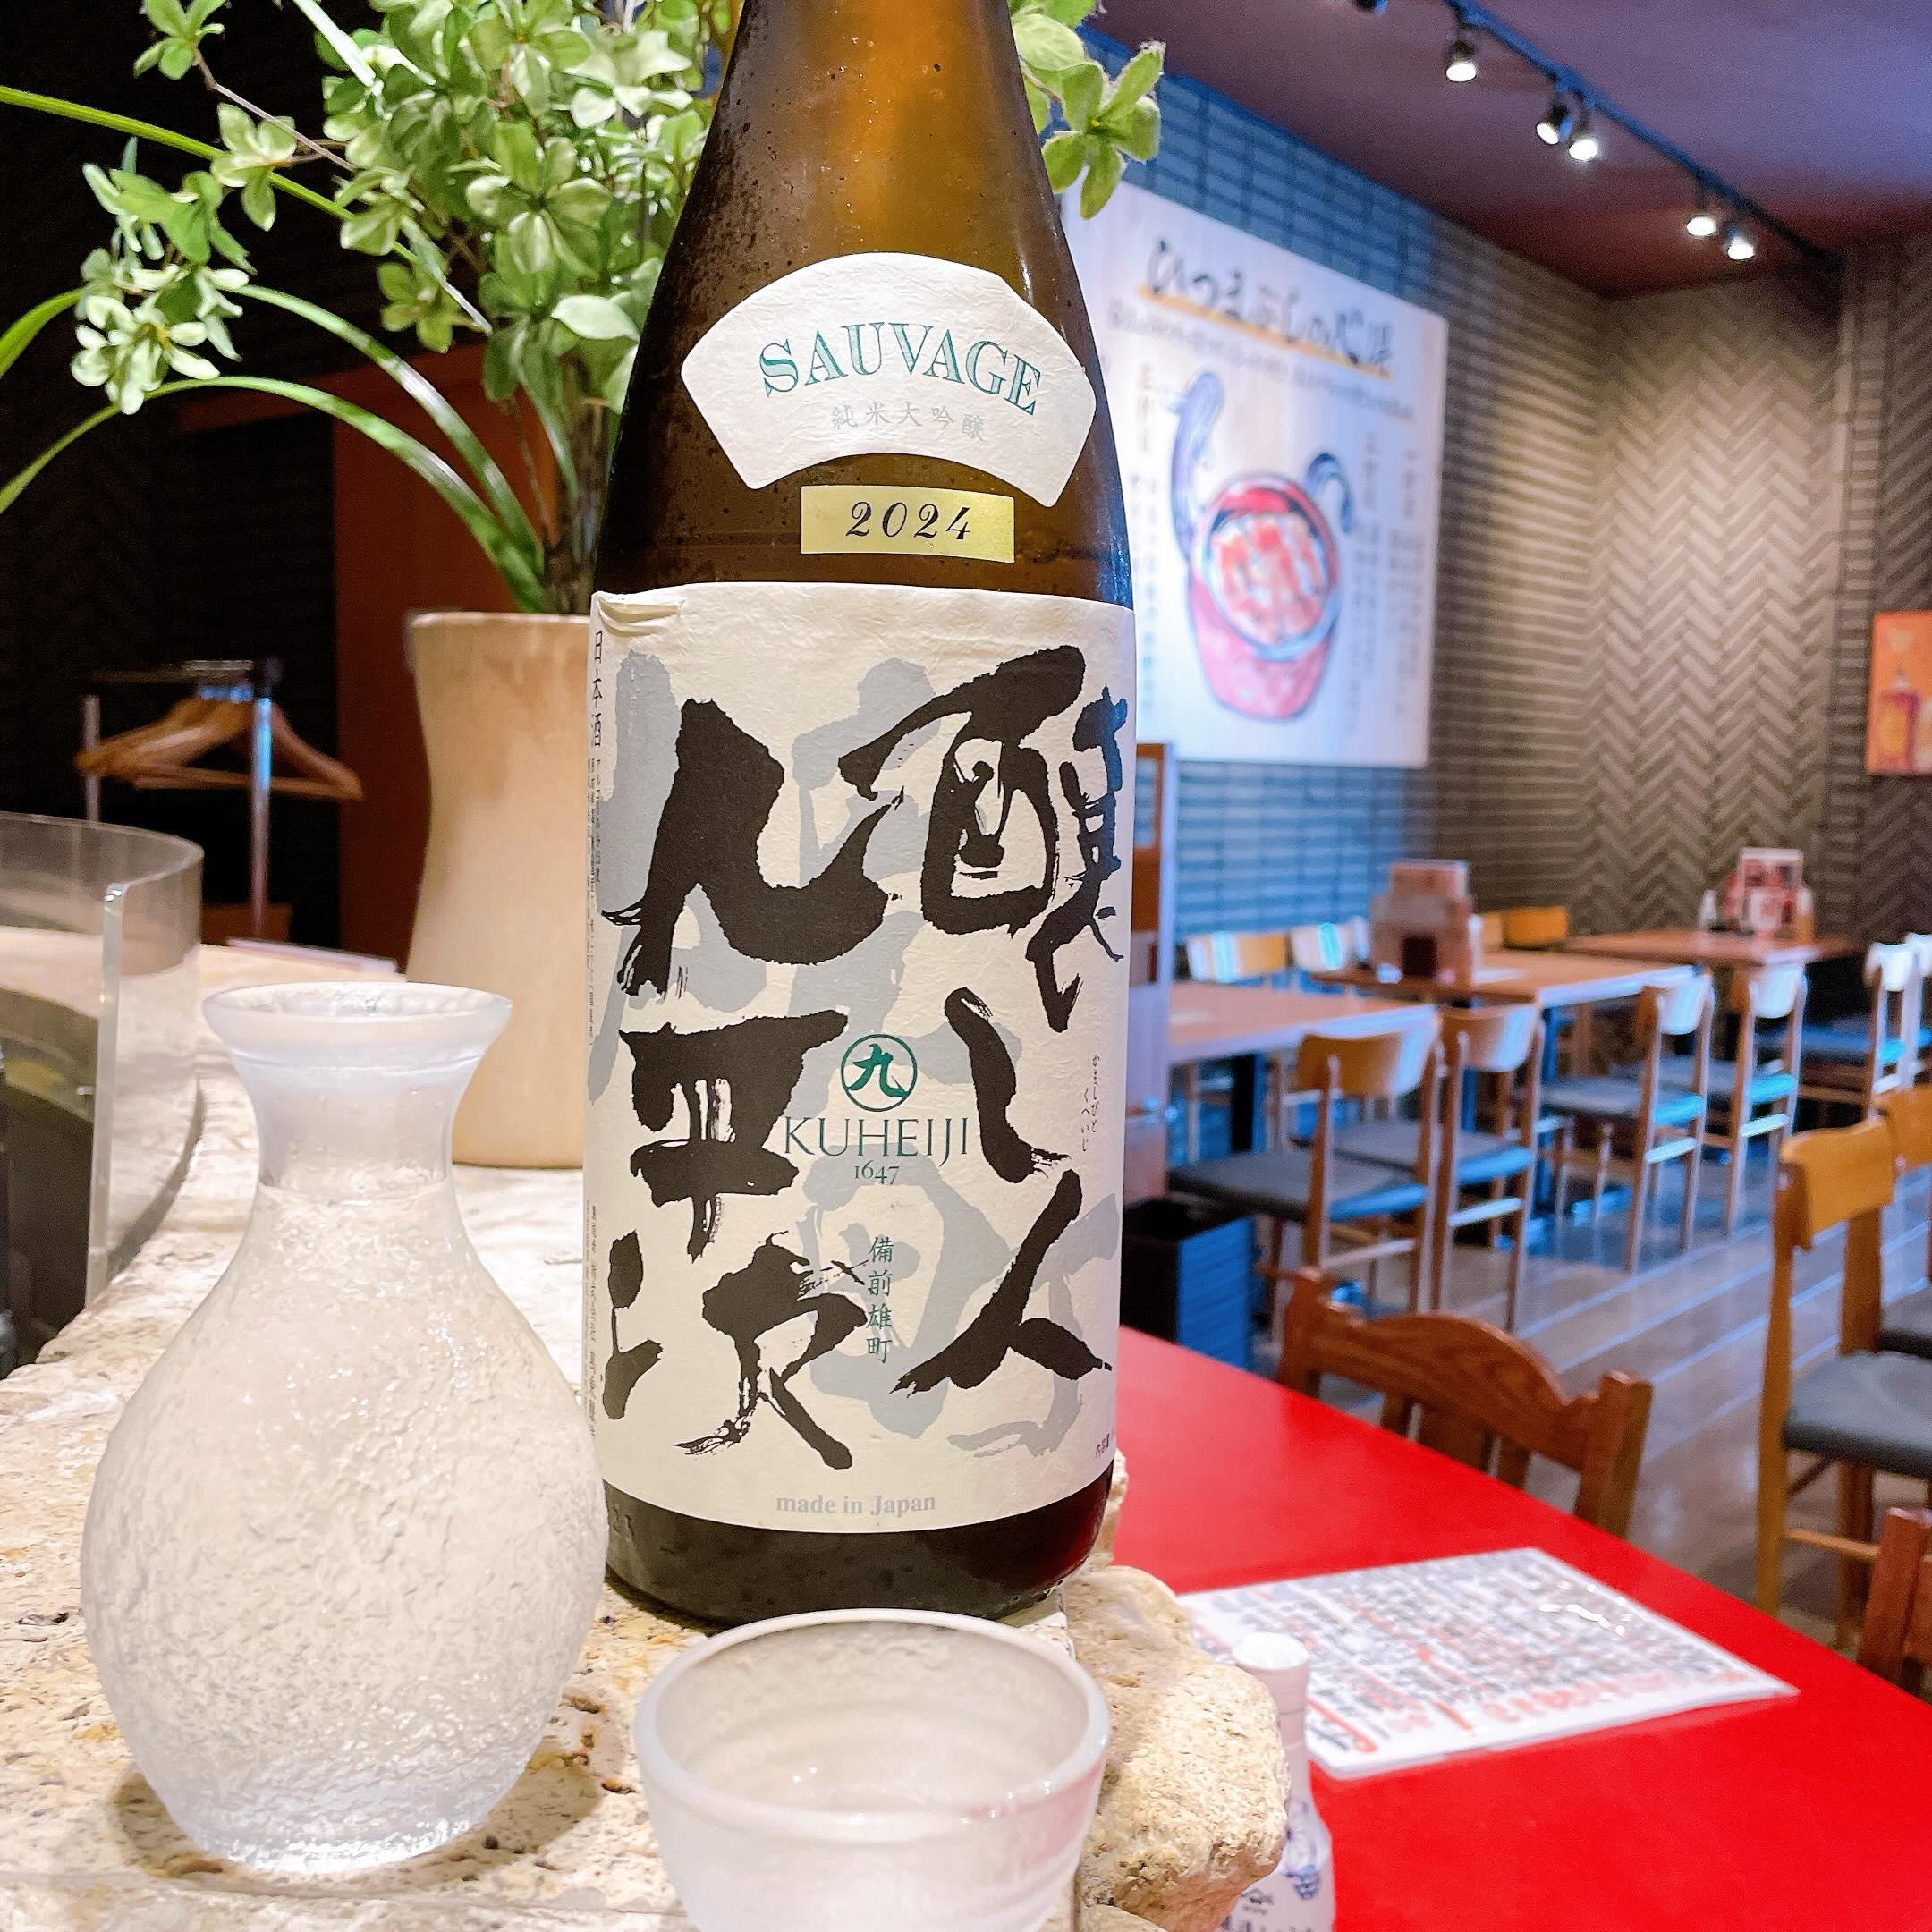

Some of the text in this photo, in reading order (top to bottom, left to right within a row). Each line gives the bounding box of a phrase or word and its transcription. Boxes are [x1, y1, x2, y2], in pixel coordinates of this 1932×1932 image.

[758, 322, 1041, 415] SAUVAGE
[831, 401, 984, 442] 純米大吟醸
[845, 502, 971, 540] 2024
[849, 1043, 910, 1099] 九
[784, 1117, 968, 1167] KUHEIJI
[854, 1160, 900, 1186] 1647
[866, 1236, 894, 1364] 備前雄町
[776, 1495, 936, 1517] made in Japan
